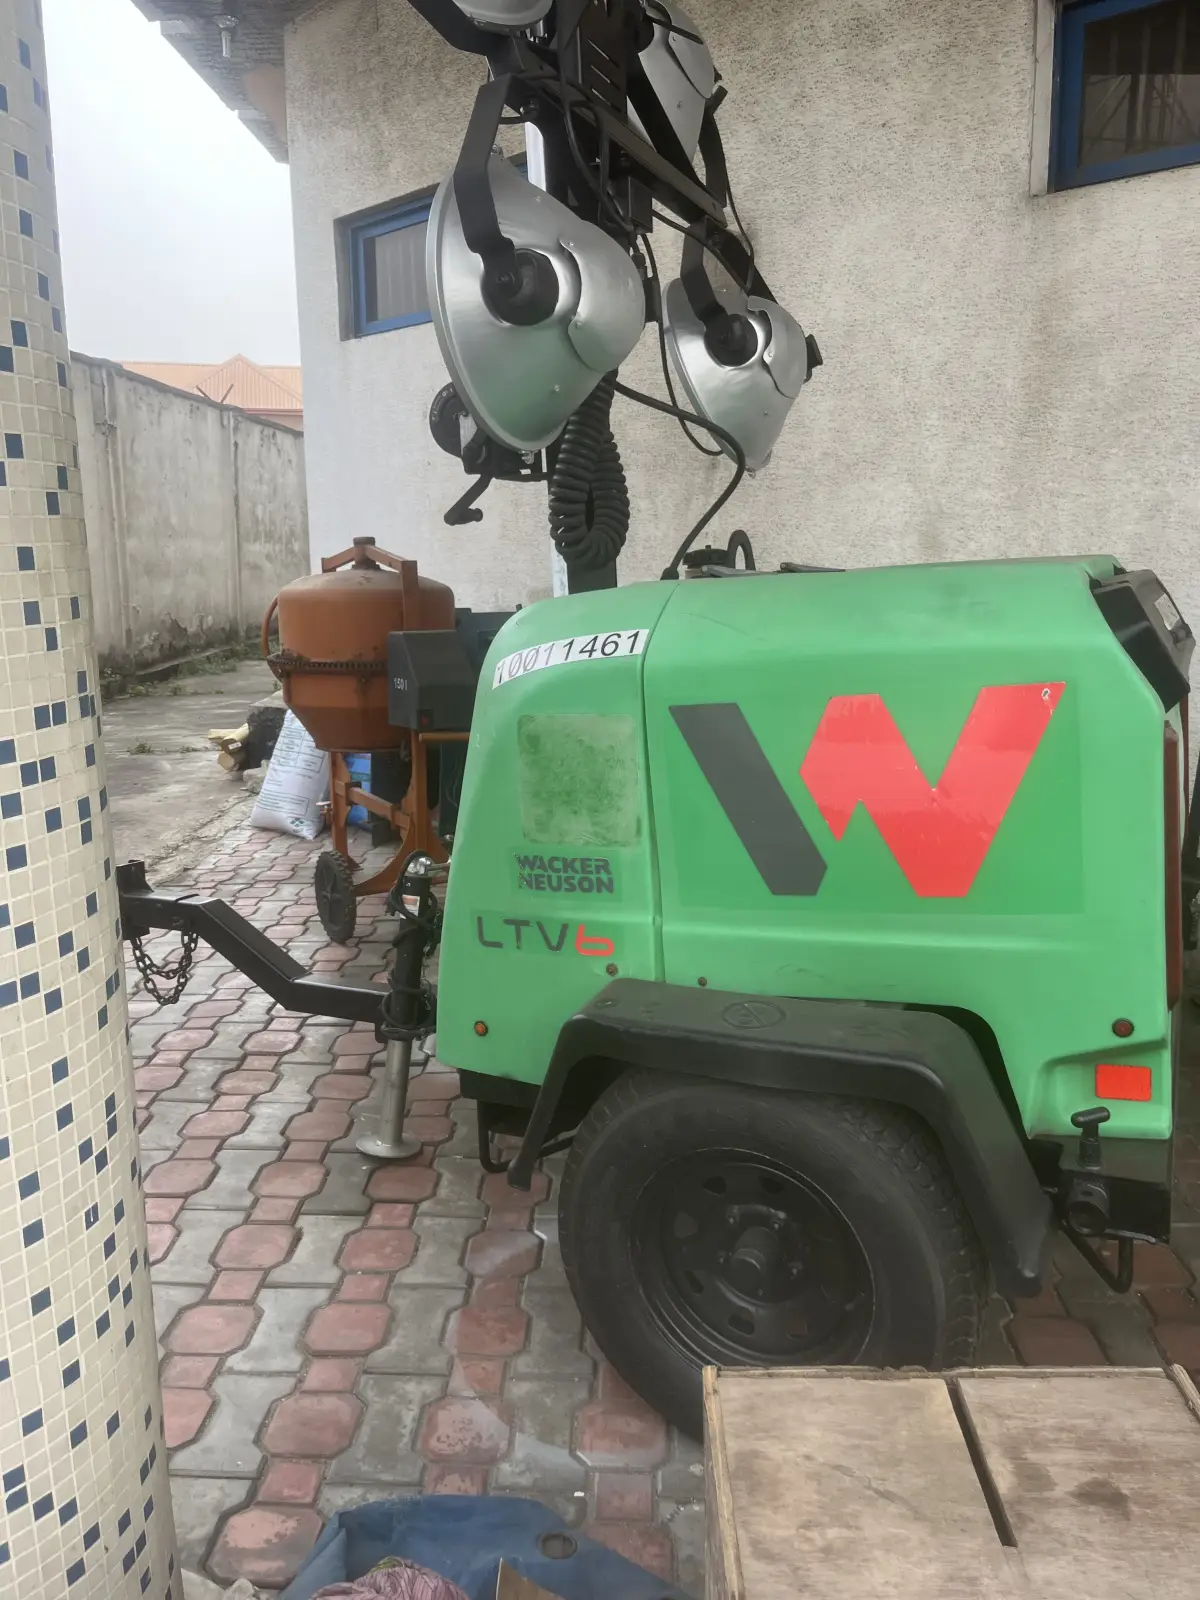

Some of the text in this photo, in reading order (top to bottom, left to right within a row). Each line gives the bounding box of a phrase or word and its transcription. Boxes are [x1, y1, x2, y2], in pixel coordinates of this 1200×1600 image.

[497, 629, 641, 685] 10011461
[515, 853, 613, 876] WACKER
[519, 872, 614, 894] NEUSON
[476, 915, 615, 957] LTV6
